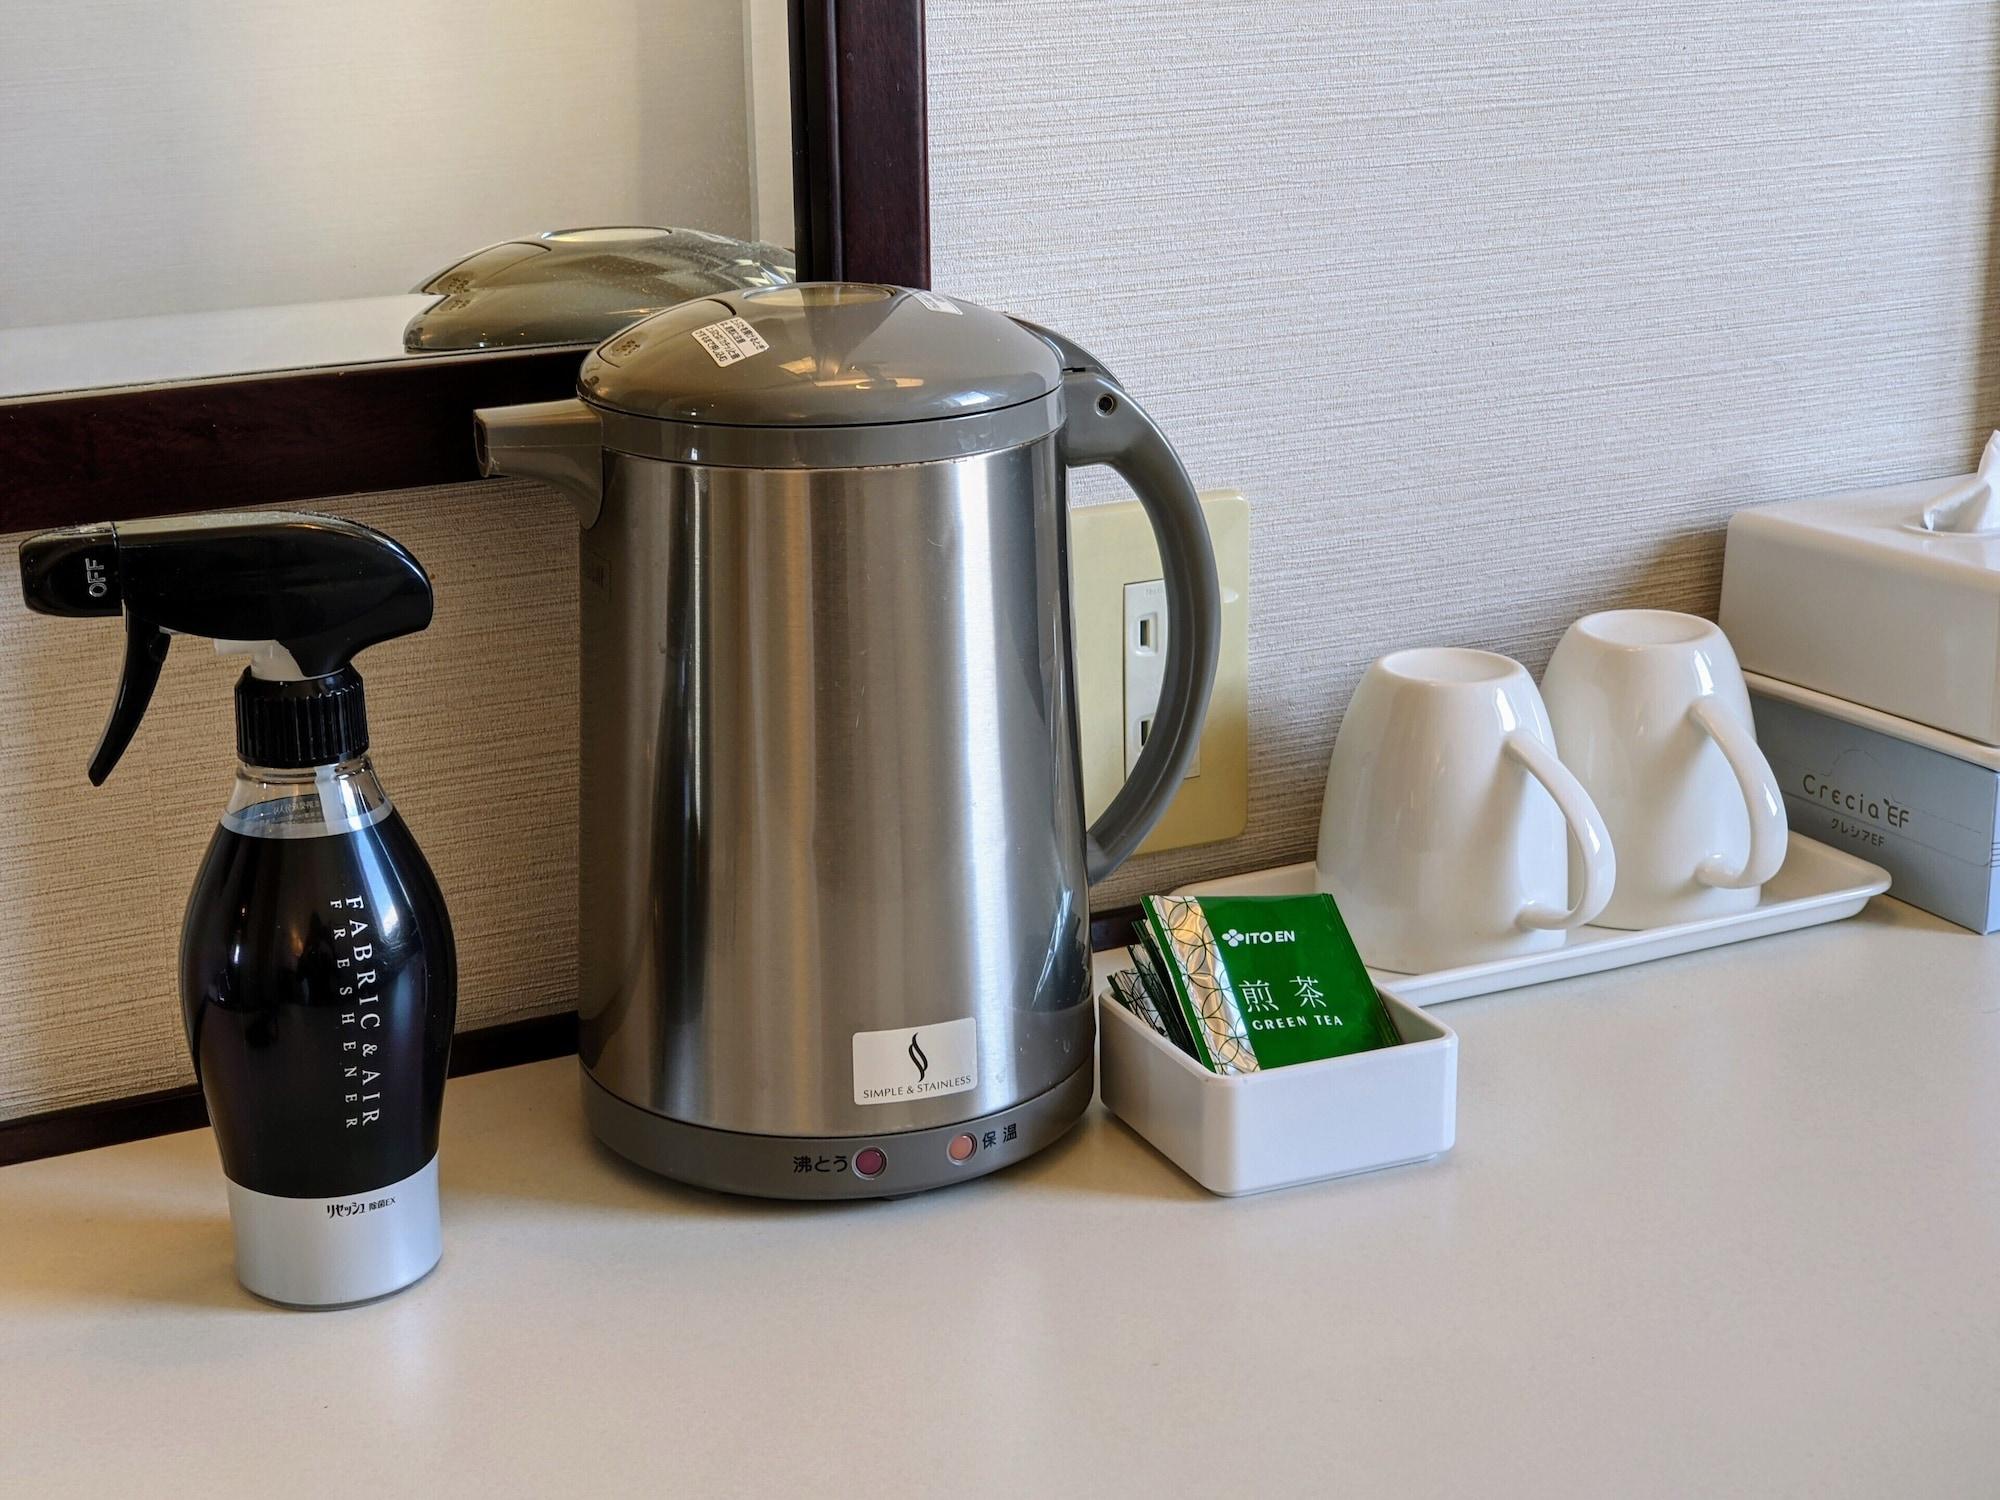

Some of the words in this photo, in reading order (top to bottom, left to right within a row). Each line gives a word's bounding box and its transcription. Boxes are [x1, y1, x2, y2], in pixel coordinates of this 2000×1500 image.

[85, 558, 107, 597] OFF
[1803, 774, 1880, 819] Crecia
[1831, 818, 1885, 847] クレシアEF
[345, 895, 381, 1030] FABRIC
[1238, 975, 1327, 1013] 煎茶
[330, 899, 358, 1128] FRESHENER
[1252, 1015, 1308, 1031] GREEN
[1313, 1014, 1344, 1026] TEA
[362, 1043, 378, 1058] &
[362, 1069, 381, 1127] AIR
[863, 1086, 904, 1099] SIMPLE
[906, 1085, 915, 1094] &
[916, 1075, 972, 1093] STAINLESS
[981, 1122, 1018, 1150] 保温
[792, 1155, 849, 1173] 沸とう
[327, 1202, 366, 1219] リセッシュ
